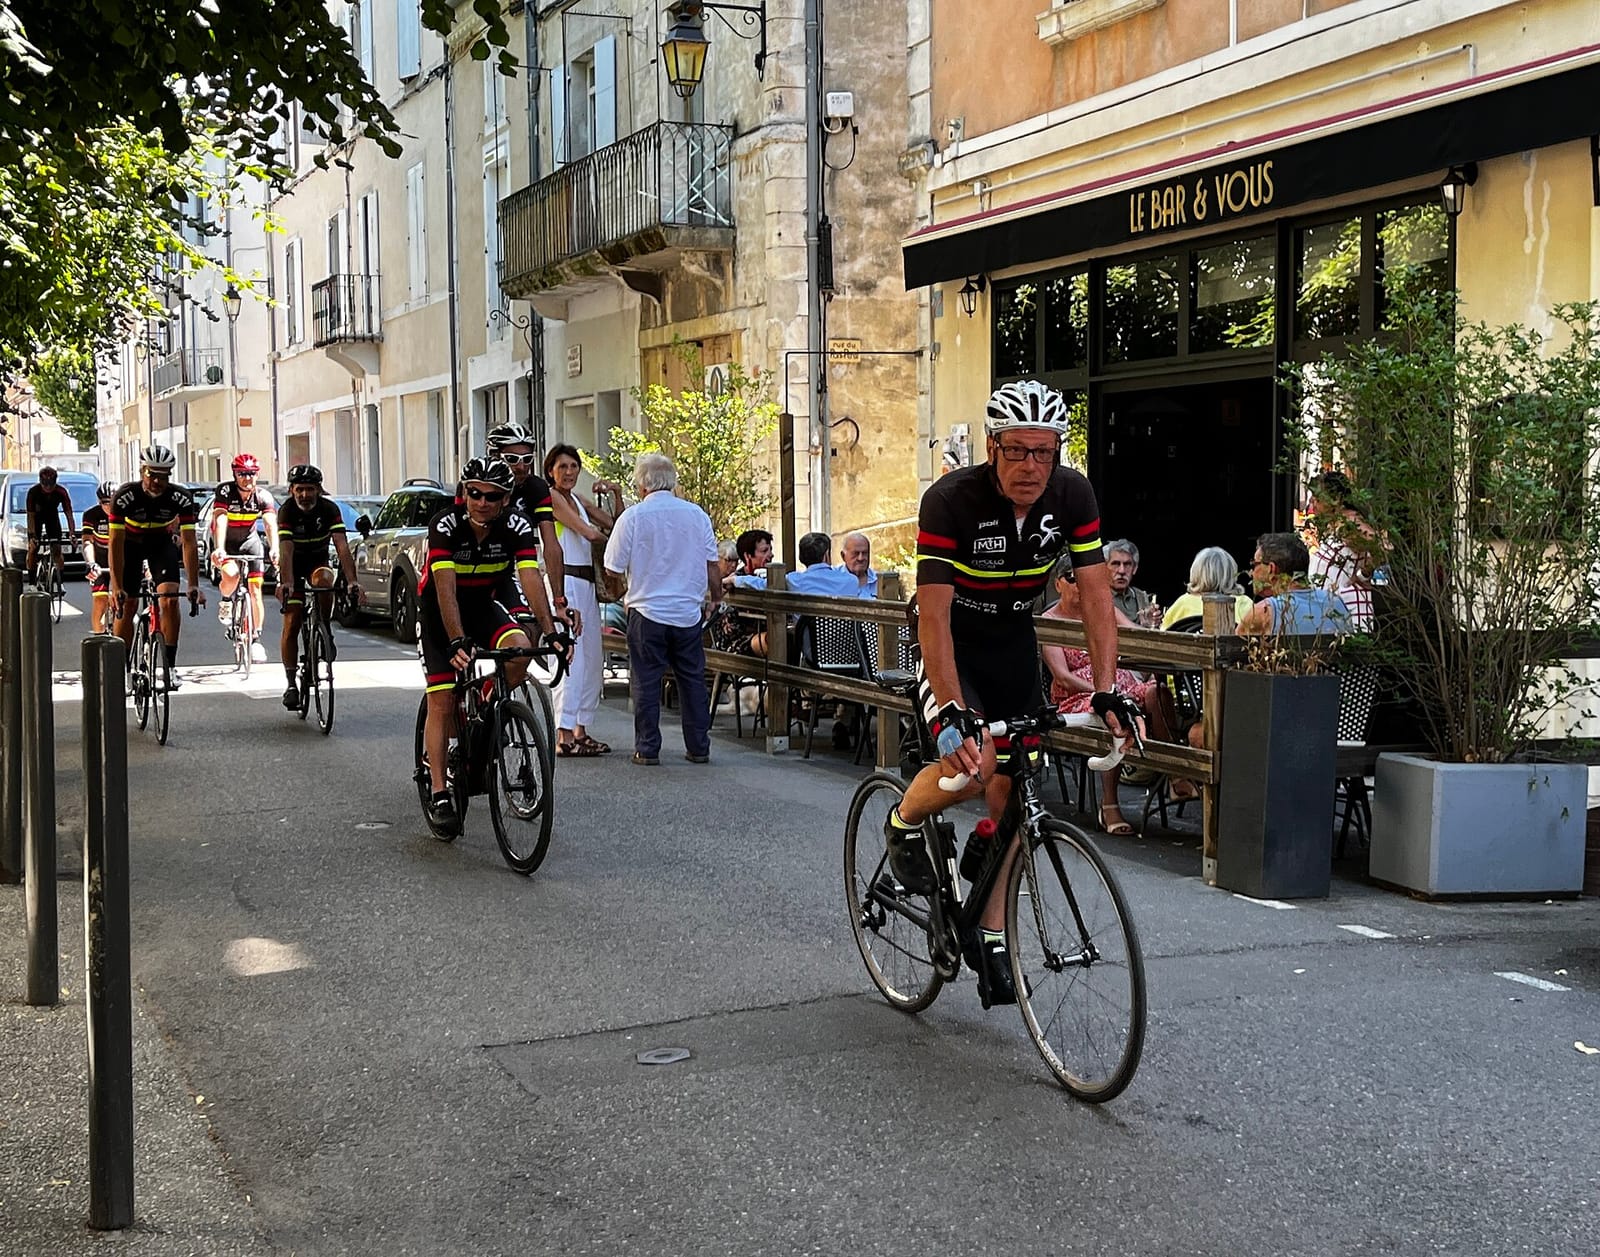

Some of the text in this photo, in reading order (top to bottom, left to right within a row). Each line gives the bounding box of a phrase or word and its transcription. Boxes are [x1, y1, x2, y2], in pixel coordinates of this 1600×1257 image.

[1130, 160, 1274, 233] LE BAR & VOUS
[171, 491, 192, 508] STV
